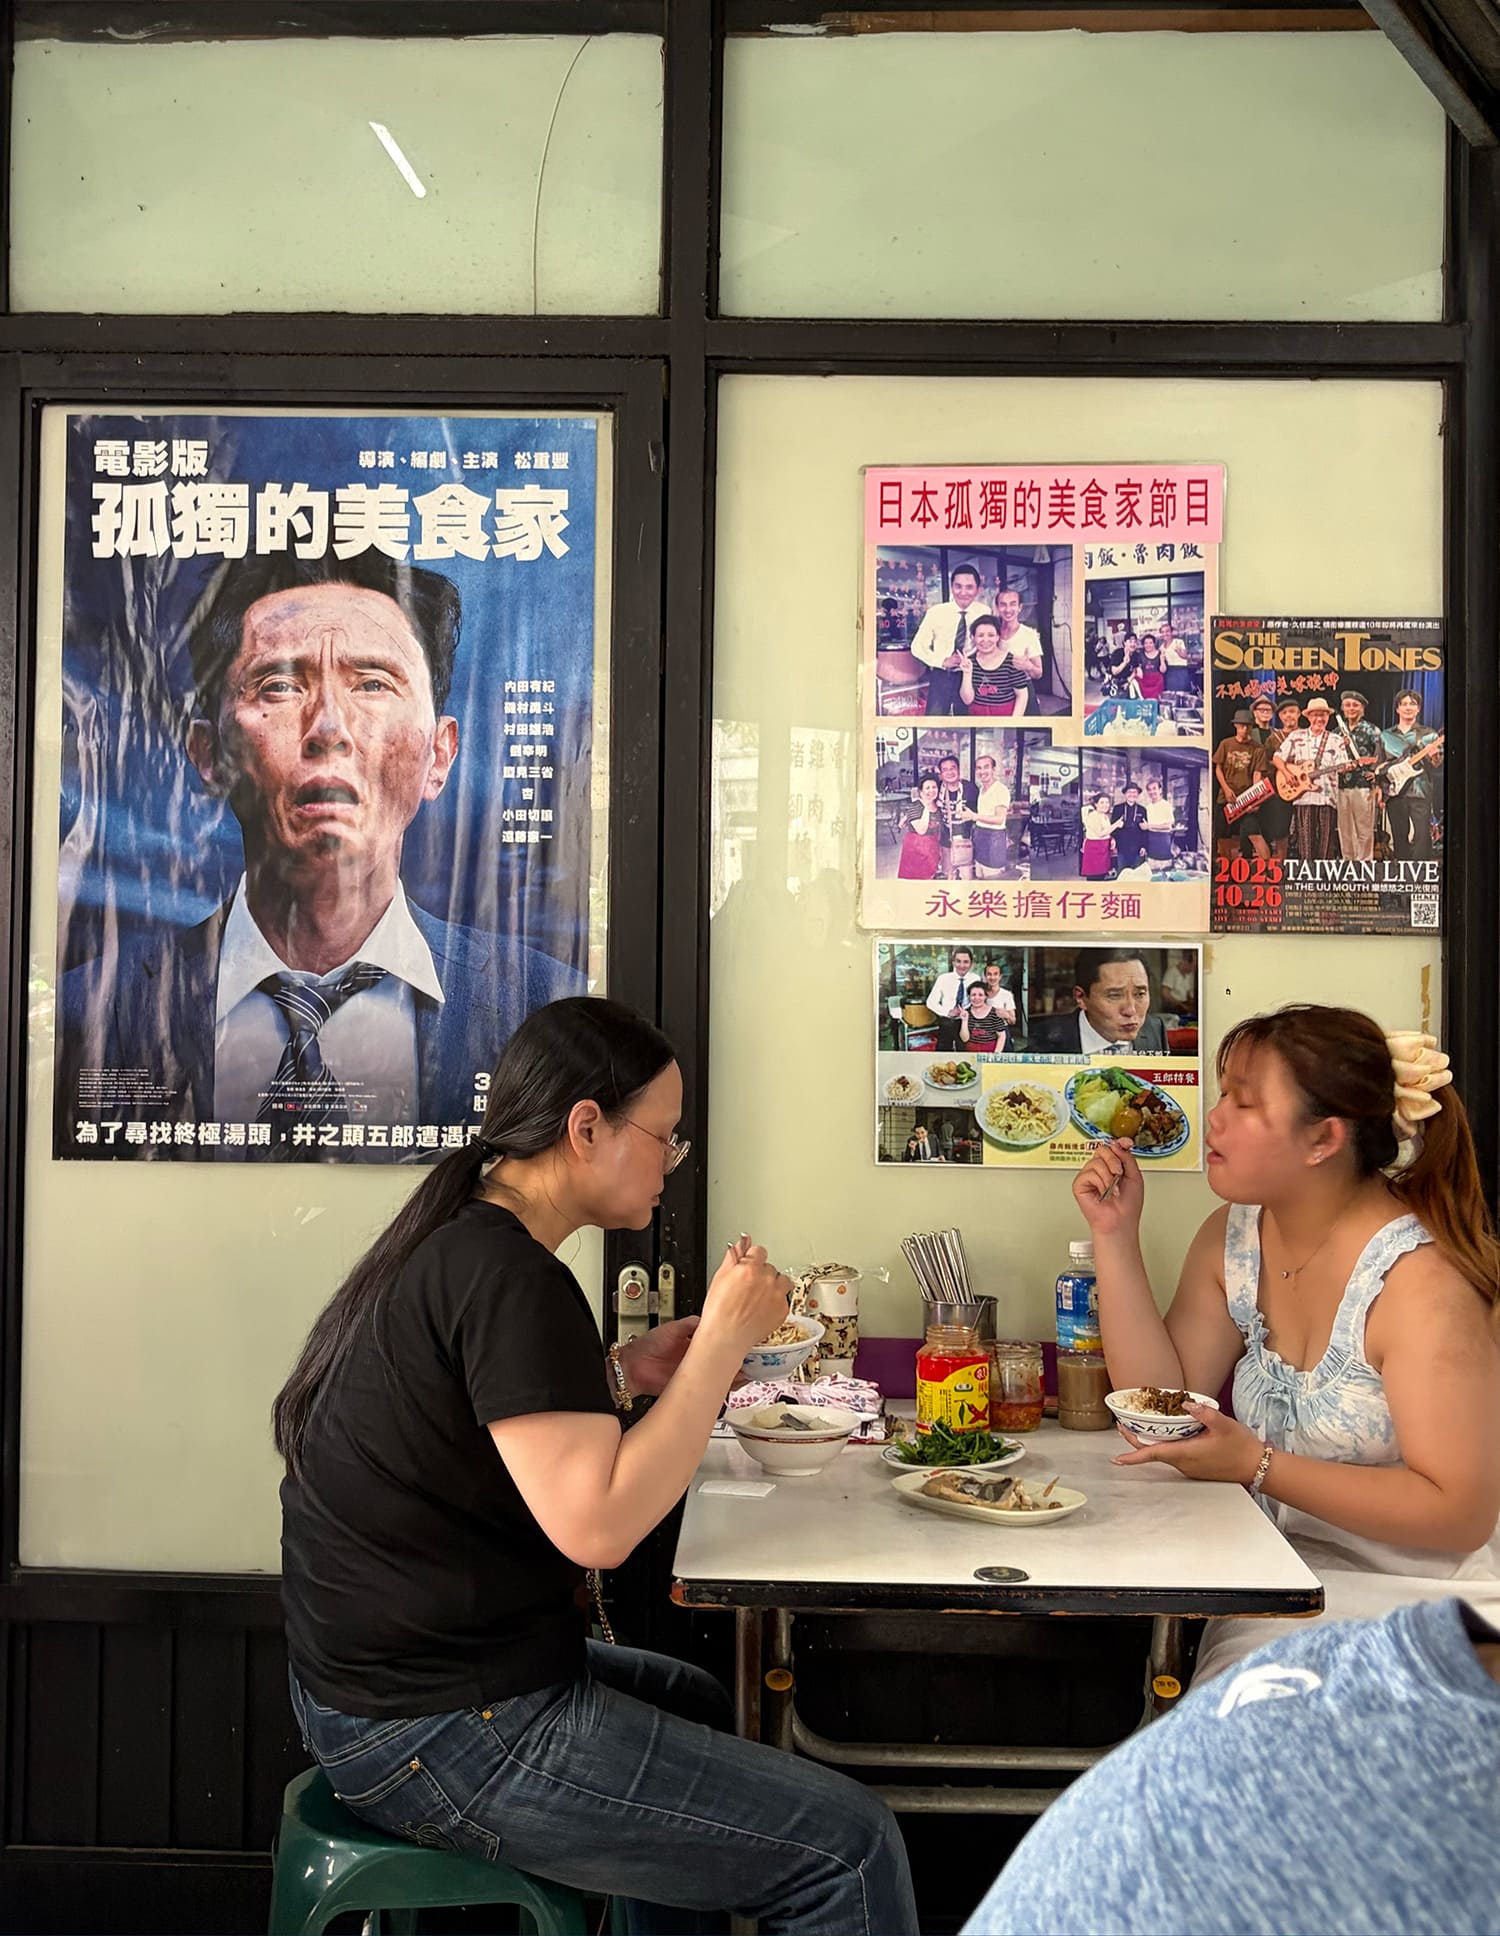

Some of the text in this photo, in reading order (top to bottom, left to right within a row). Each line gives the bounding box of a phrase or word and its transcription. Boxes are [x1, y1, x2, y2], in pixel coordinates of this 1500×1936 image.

[93, 440, 209, 477] 電影版
[514, 451, 569, 469] 松重豐
[879, 477, 1209, 529] 日本孤獨的美食家節目
[91, 482, 571, 562] 孤獨的美食家
[1214, 631, 1442, 671] SCREEN TONES
[1246, 632, 1281, 646] THE
[1215, 857, 1283, 884] 2025
[1283, 859, 1440, 882] TAIWAN LIVE
[1215, 885, 1282, 907] 10.26
[1294, 883, 1314, 891] THE
[1316, 883, 1331, 891] UU
[1332, 883, 1370, 892] MOUTH
[925, 889, 1141, 920] 永樂擔仔麵
[1152, 1072, 1195, 1084] 五郎特餐
